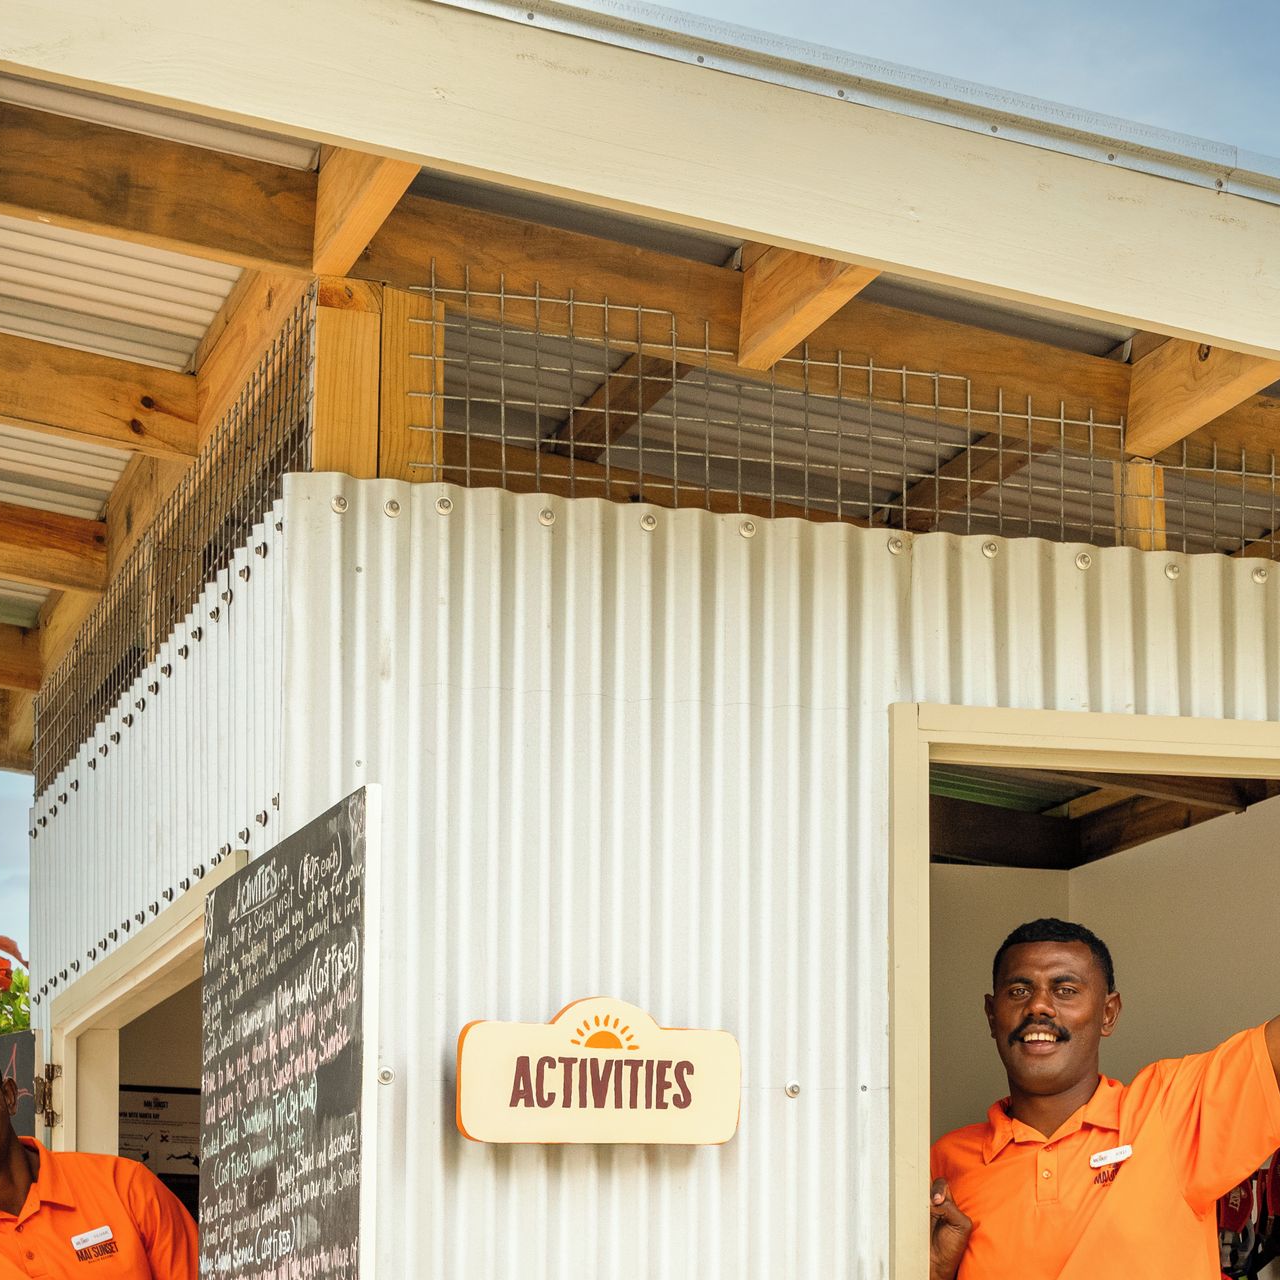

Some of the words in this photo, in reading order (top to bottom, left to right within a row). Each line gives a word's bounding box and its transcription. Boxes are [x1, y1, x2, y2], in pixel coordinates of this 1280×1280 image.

[231, 924, 247, 951] Tour
[253, 902, 275, 934] School
[276, 875, 295, 917] visit
[320, 832, 342, 877] each)
[330, 870, 344, 904] for
[509, 1055, 695, 1110] ACTIVITIES
[221, 1116, 239, 1149] Island
[91, 1241, 119, 1259] SUNSET
